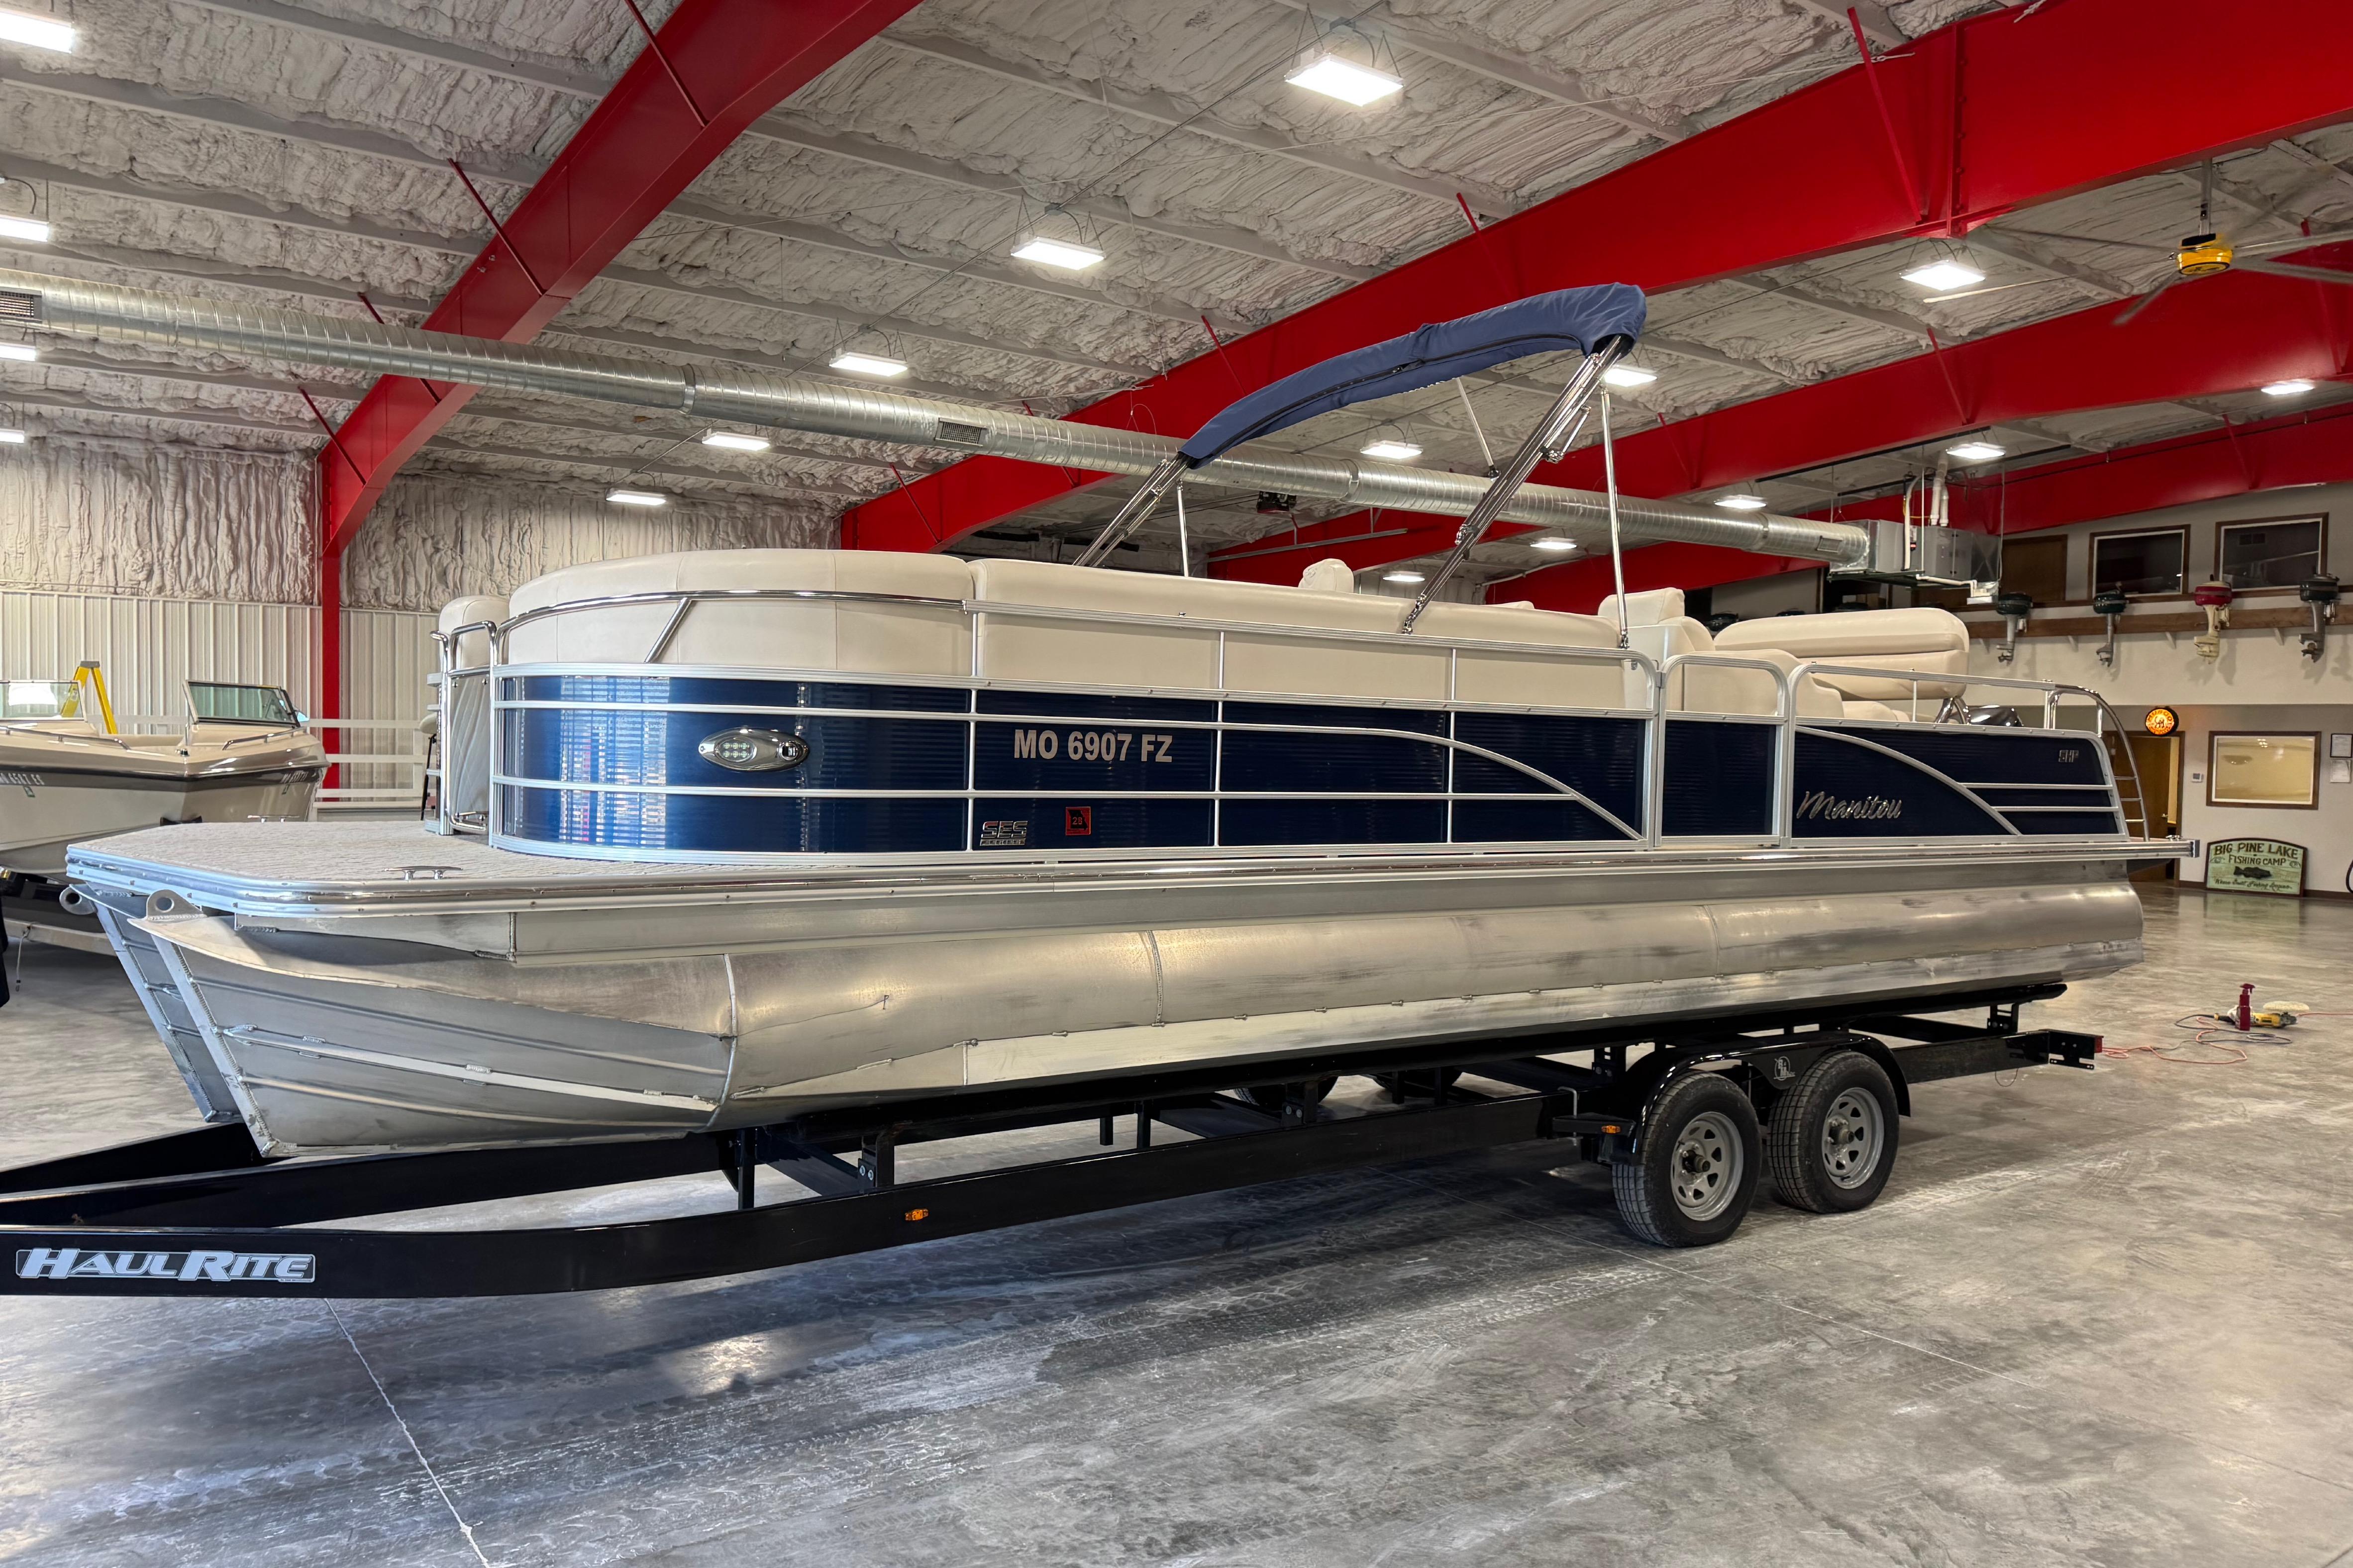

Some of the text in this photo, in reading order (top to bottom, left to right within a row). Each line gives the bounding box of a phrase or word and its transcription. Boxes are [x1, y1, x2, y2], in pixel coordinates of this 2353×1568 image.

[1014, 729, 1173, 762] MO 6907 FZ
[1796, 791, 1902, 820] Manitou
[981, 821, 1028, 838] SES
[2214, 842, 2298, 860] BIG PINE LAKE
[2229, 854, 2286, 866] FISHING CAMP
